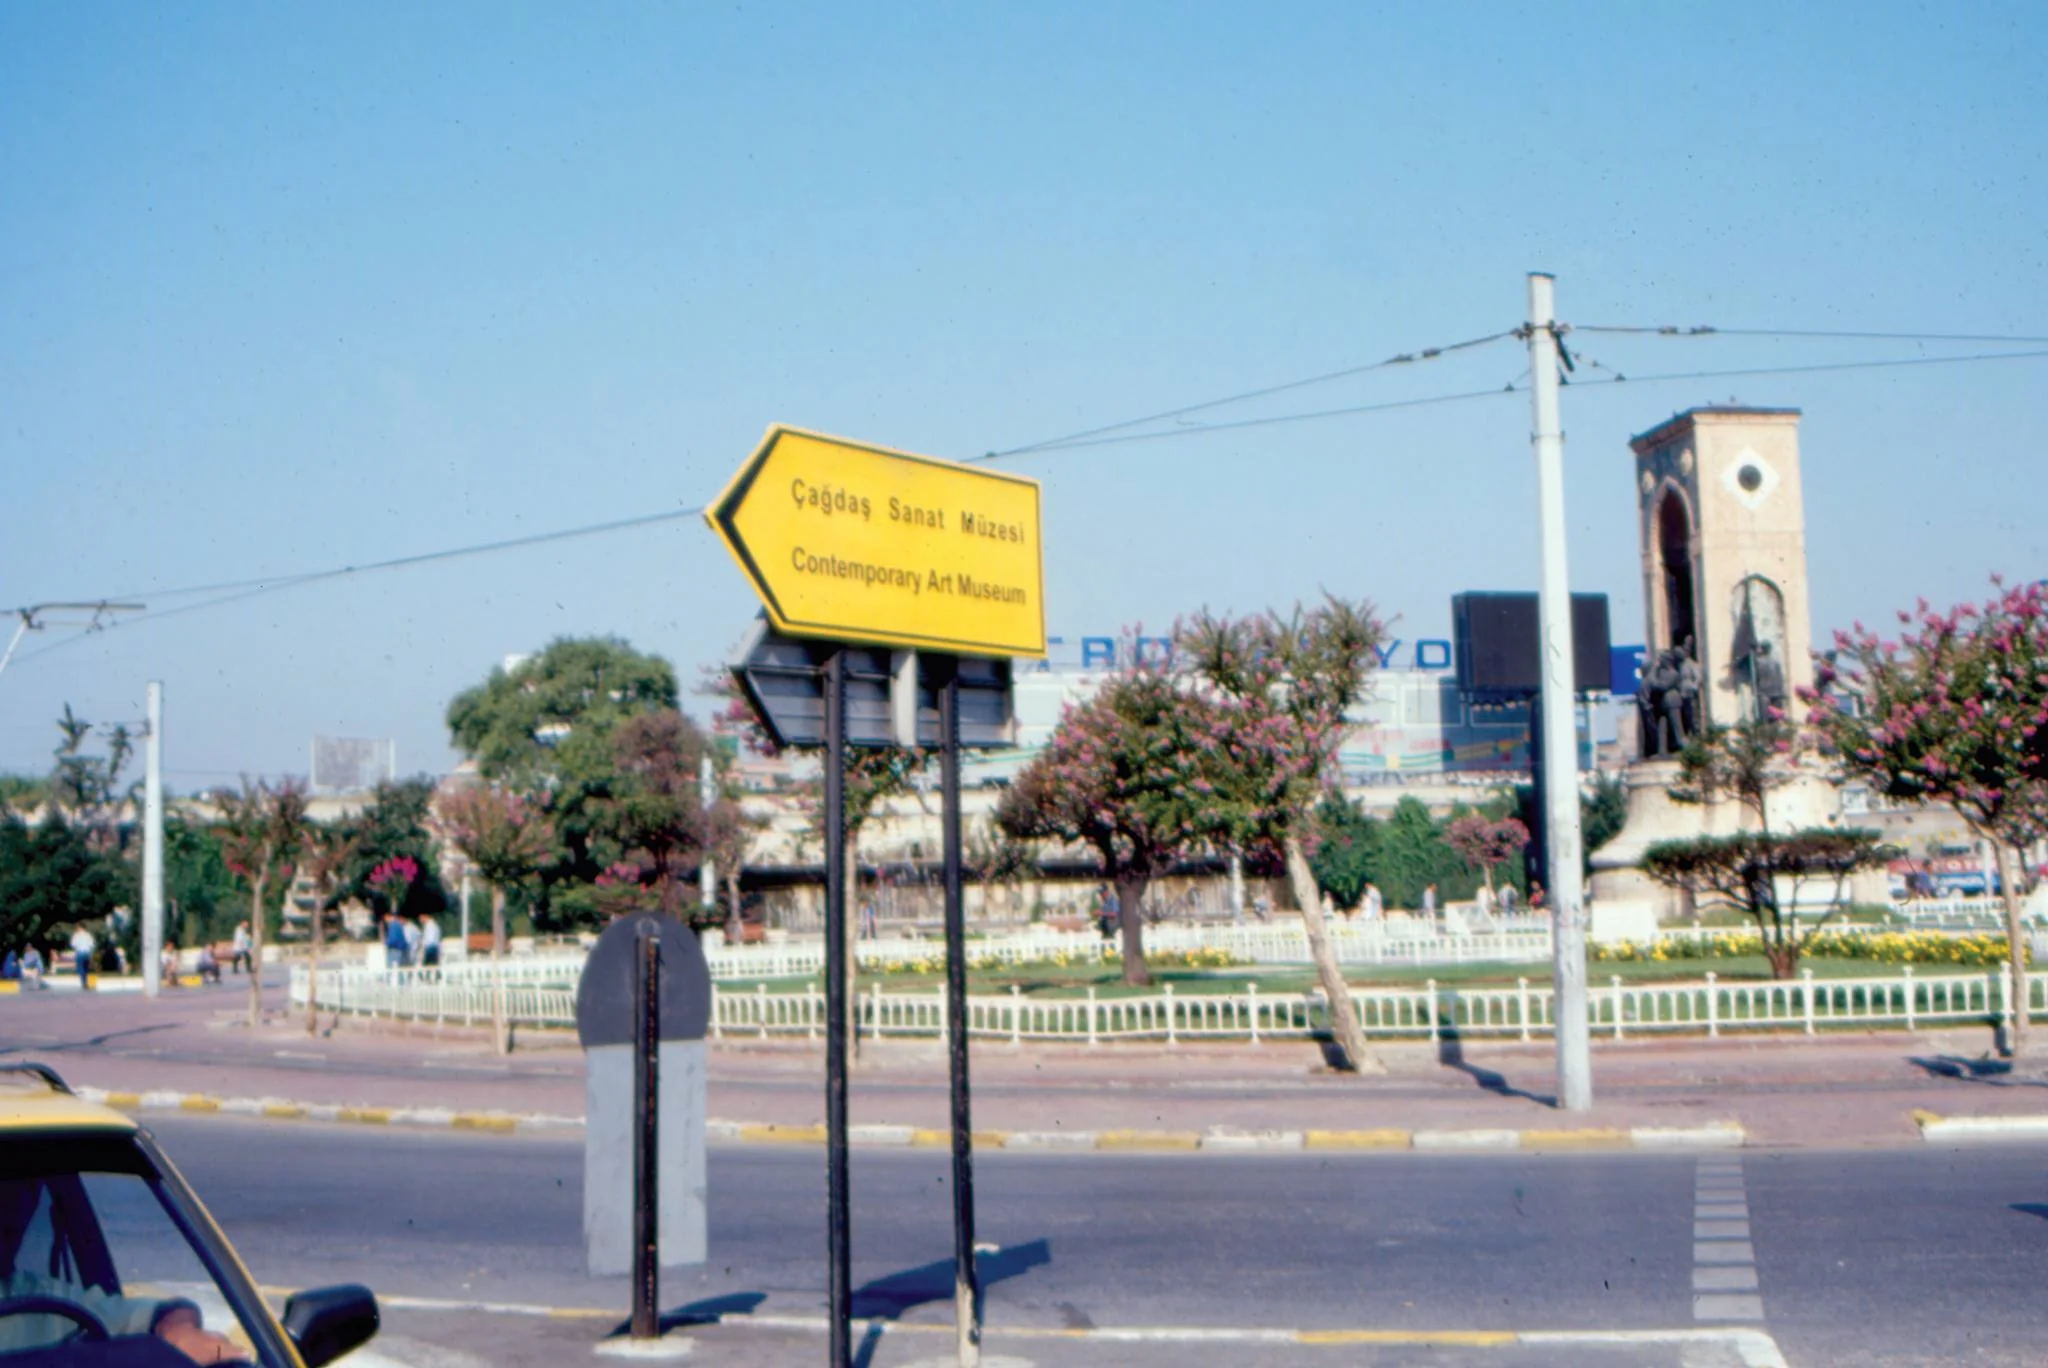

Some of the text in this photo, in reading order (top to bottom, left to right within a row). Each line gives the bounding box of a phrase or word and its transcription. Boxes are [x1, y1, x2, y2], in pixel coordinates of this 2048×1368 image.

[791, 478, 1025, 544] Çağdaş Sanat Müzesi
[791, 546, 1026, 606] Contemporary Art Museum
